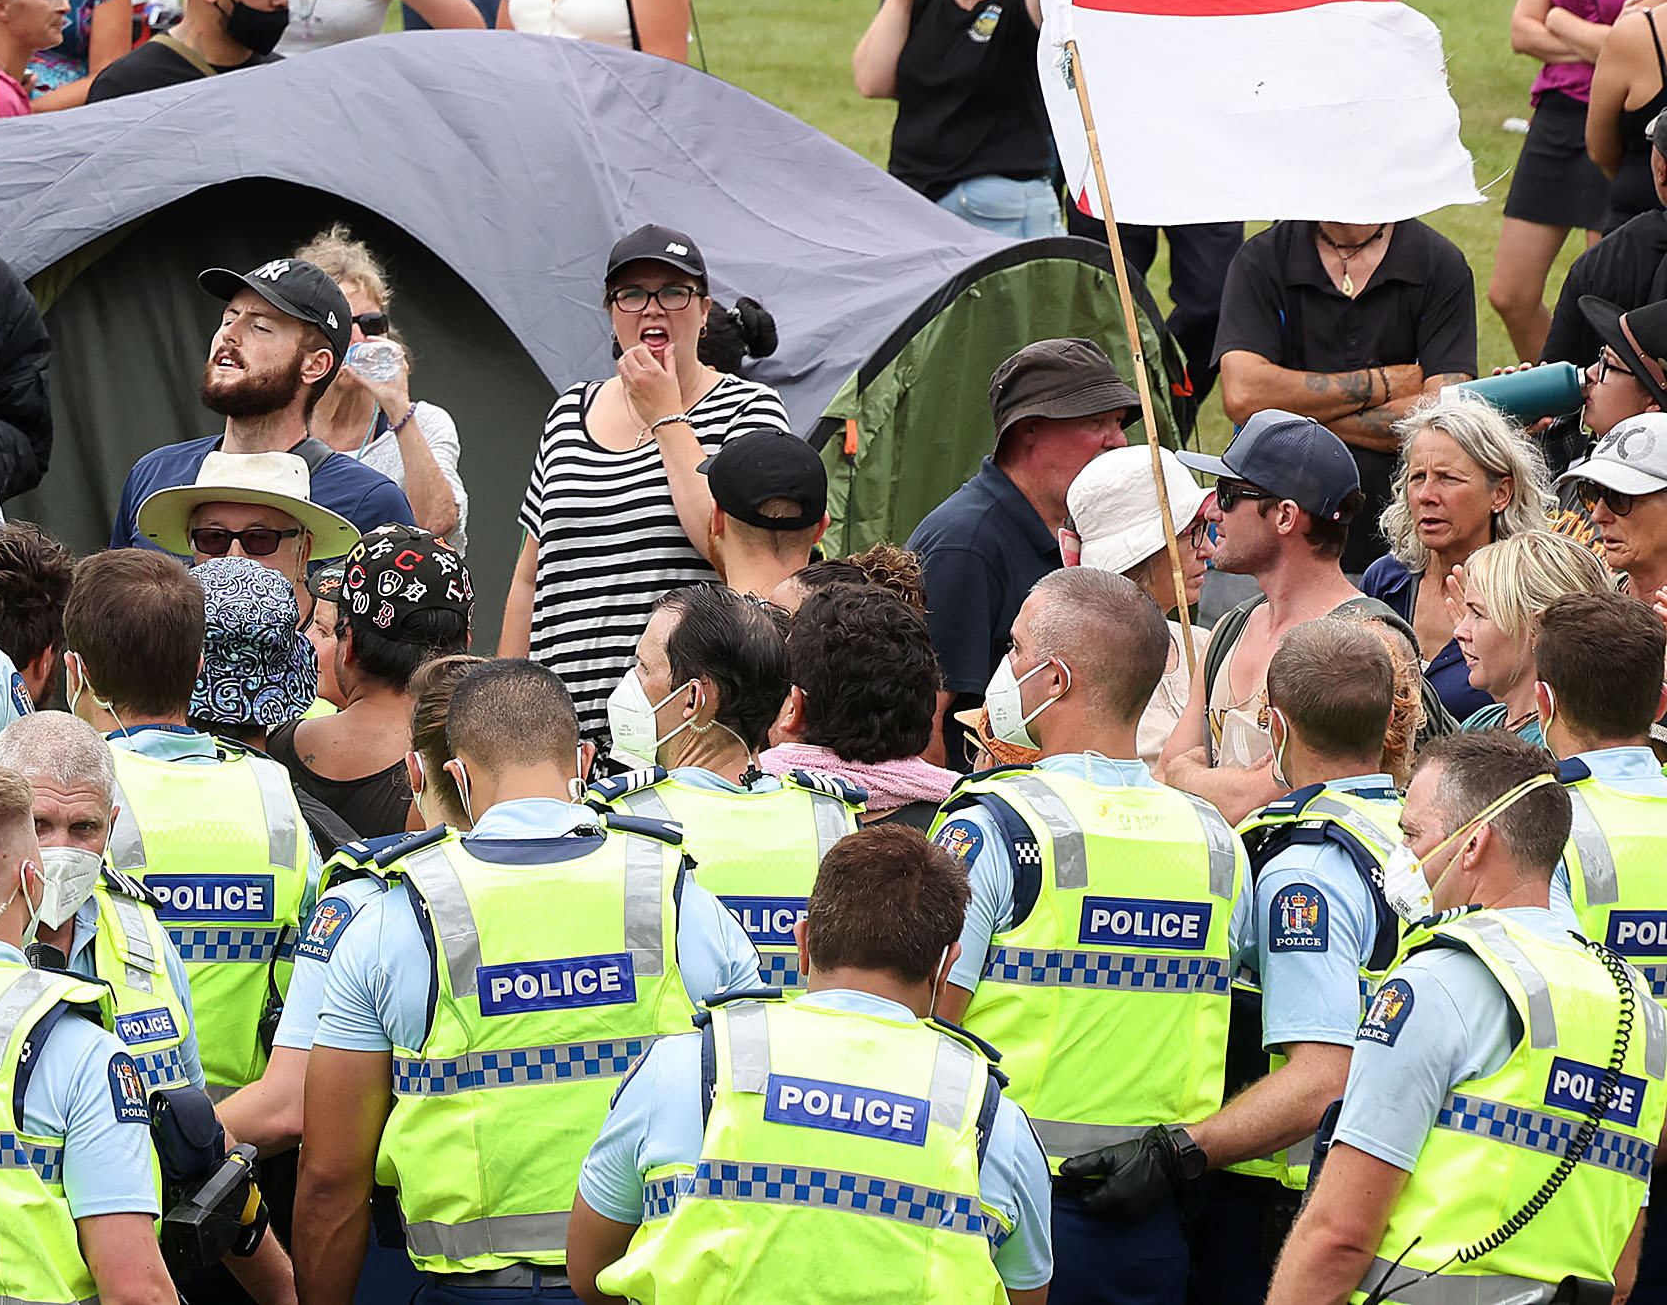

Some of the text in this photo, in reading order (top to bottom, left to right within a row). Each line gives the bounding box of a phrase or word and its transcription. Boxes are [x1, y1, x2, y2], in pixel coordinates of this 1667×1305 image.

[152, 885, 265, 911] POLICE
[1090, 909, 1202, 939] POLICE
[298, 942, 329, 957] POLICE
[1276, 937, 1322, 947] POLICE
[490, 966, 622, 1003] POLICE
[122, 1015, 173, 1037] POLICE
[1358, 1026, 1390, 1043] POLICE
[777, 1085, 916, 1133] POLICE
